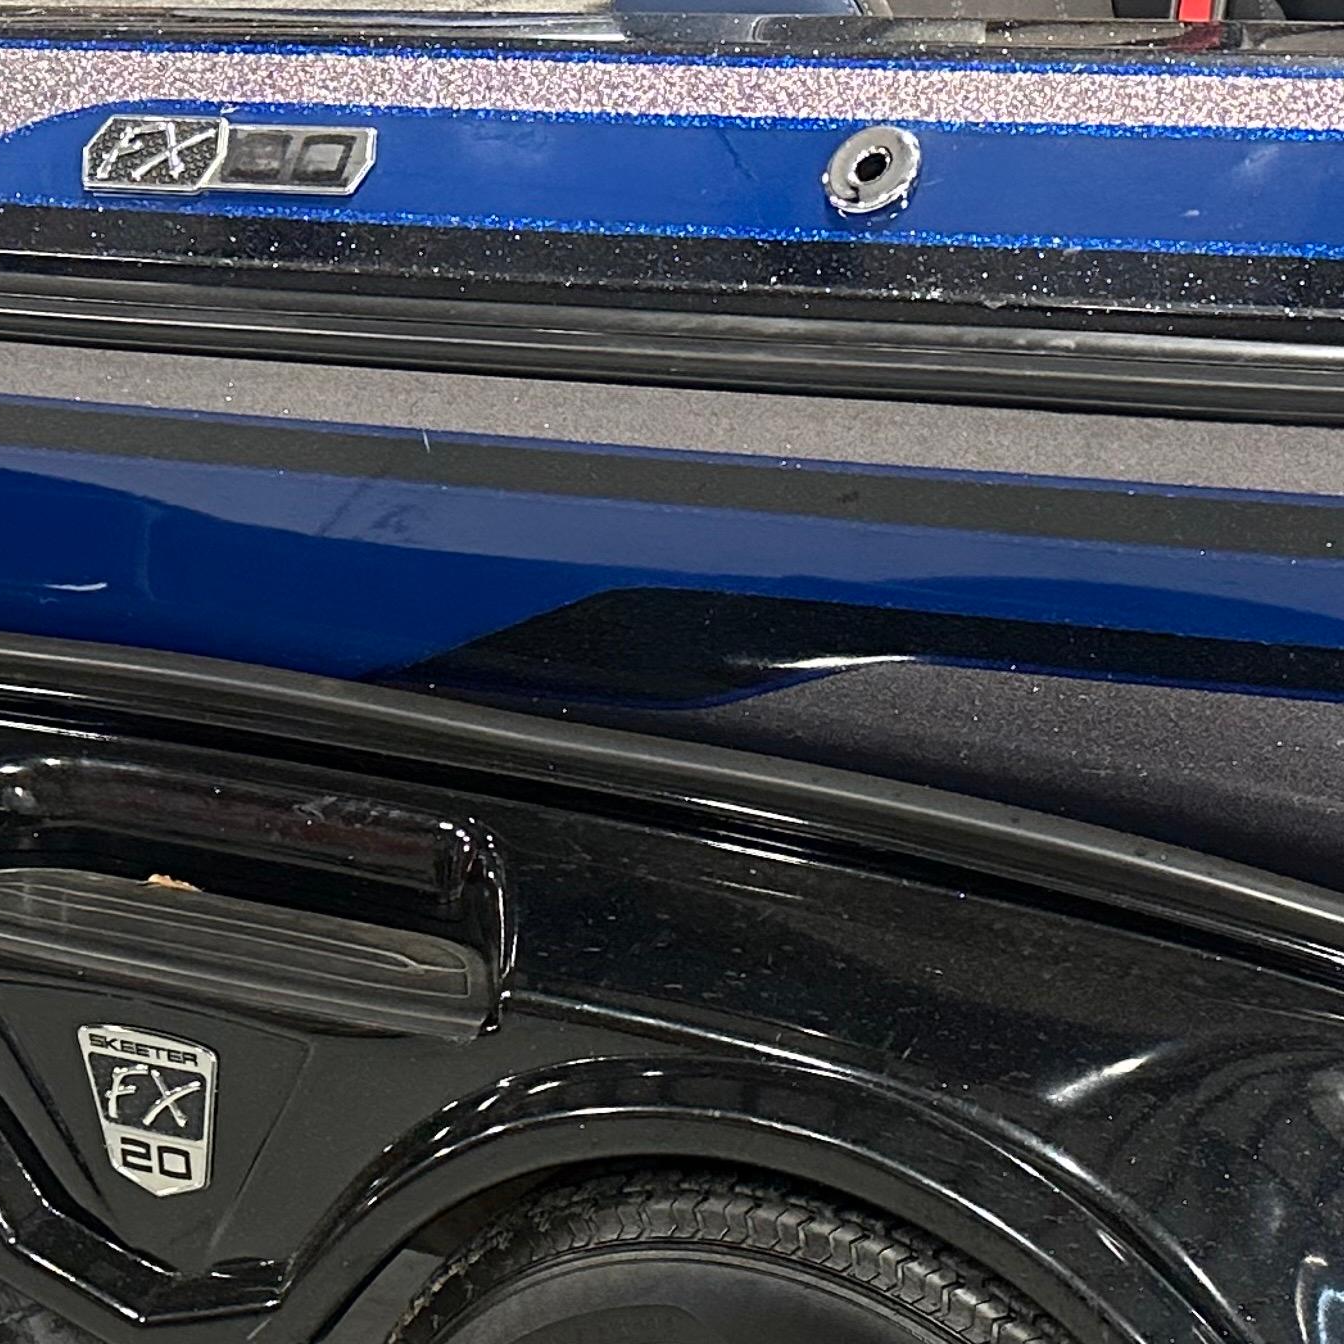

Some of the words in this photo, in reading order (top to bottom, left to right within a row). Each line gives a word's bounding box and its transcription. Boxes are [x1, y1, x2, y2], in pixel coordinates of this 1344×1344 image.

[96, 122, 218, 182] FX
[88, 1032, 199, 1068] SKEETER
[105, 1063, 202, 1128] FX
[120, 1136, 193, 1181] 20
